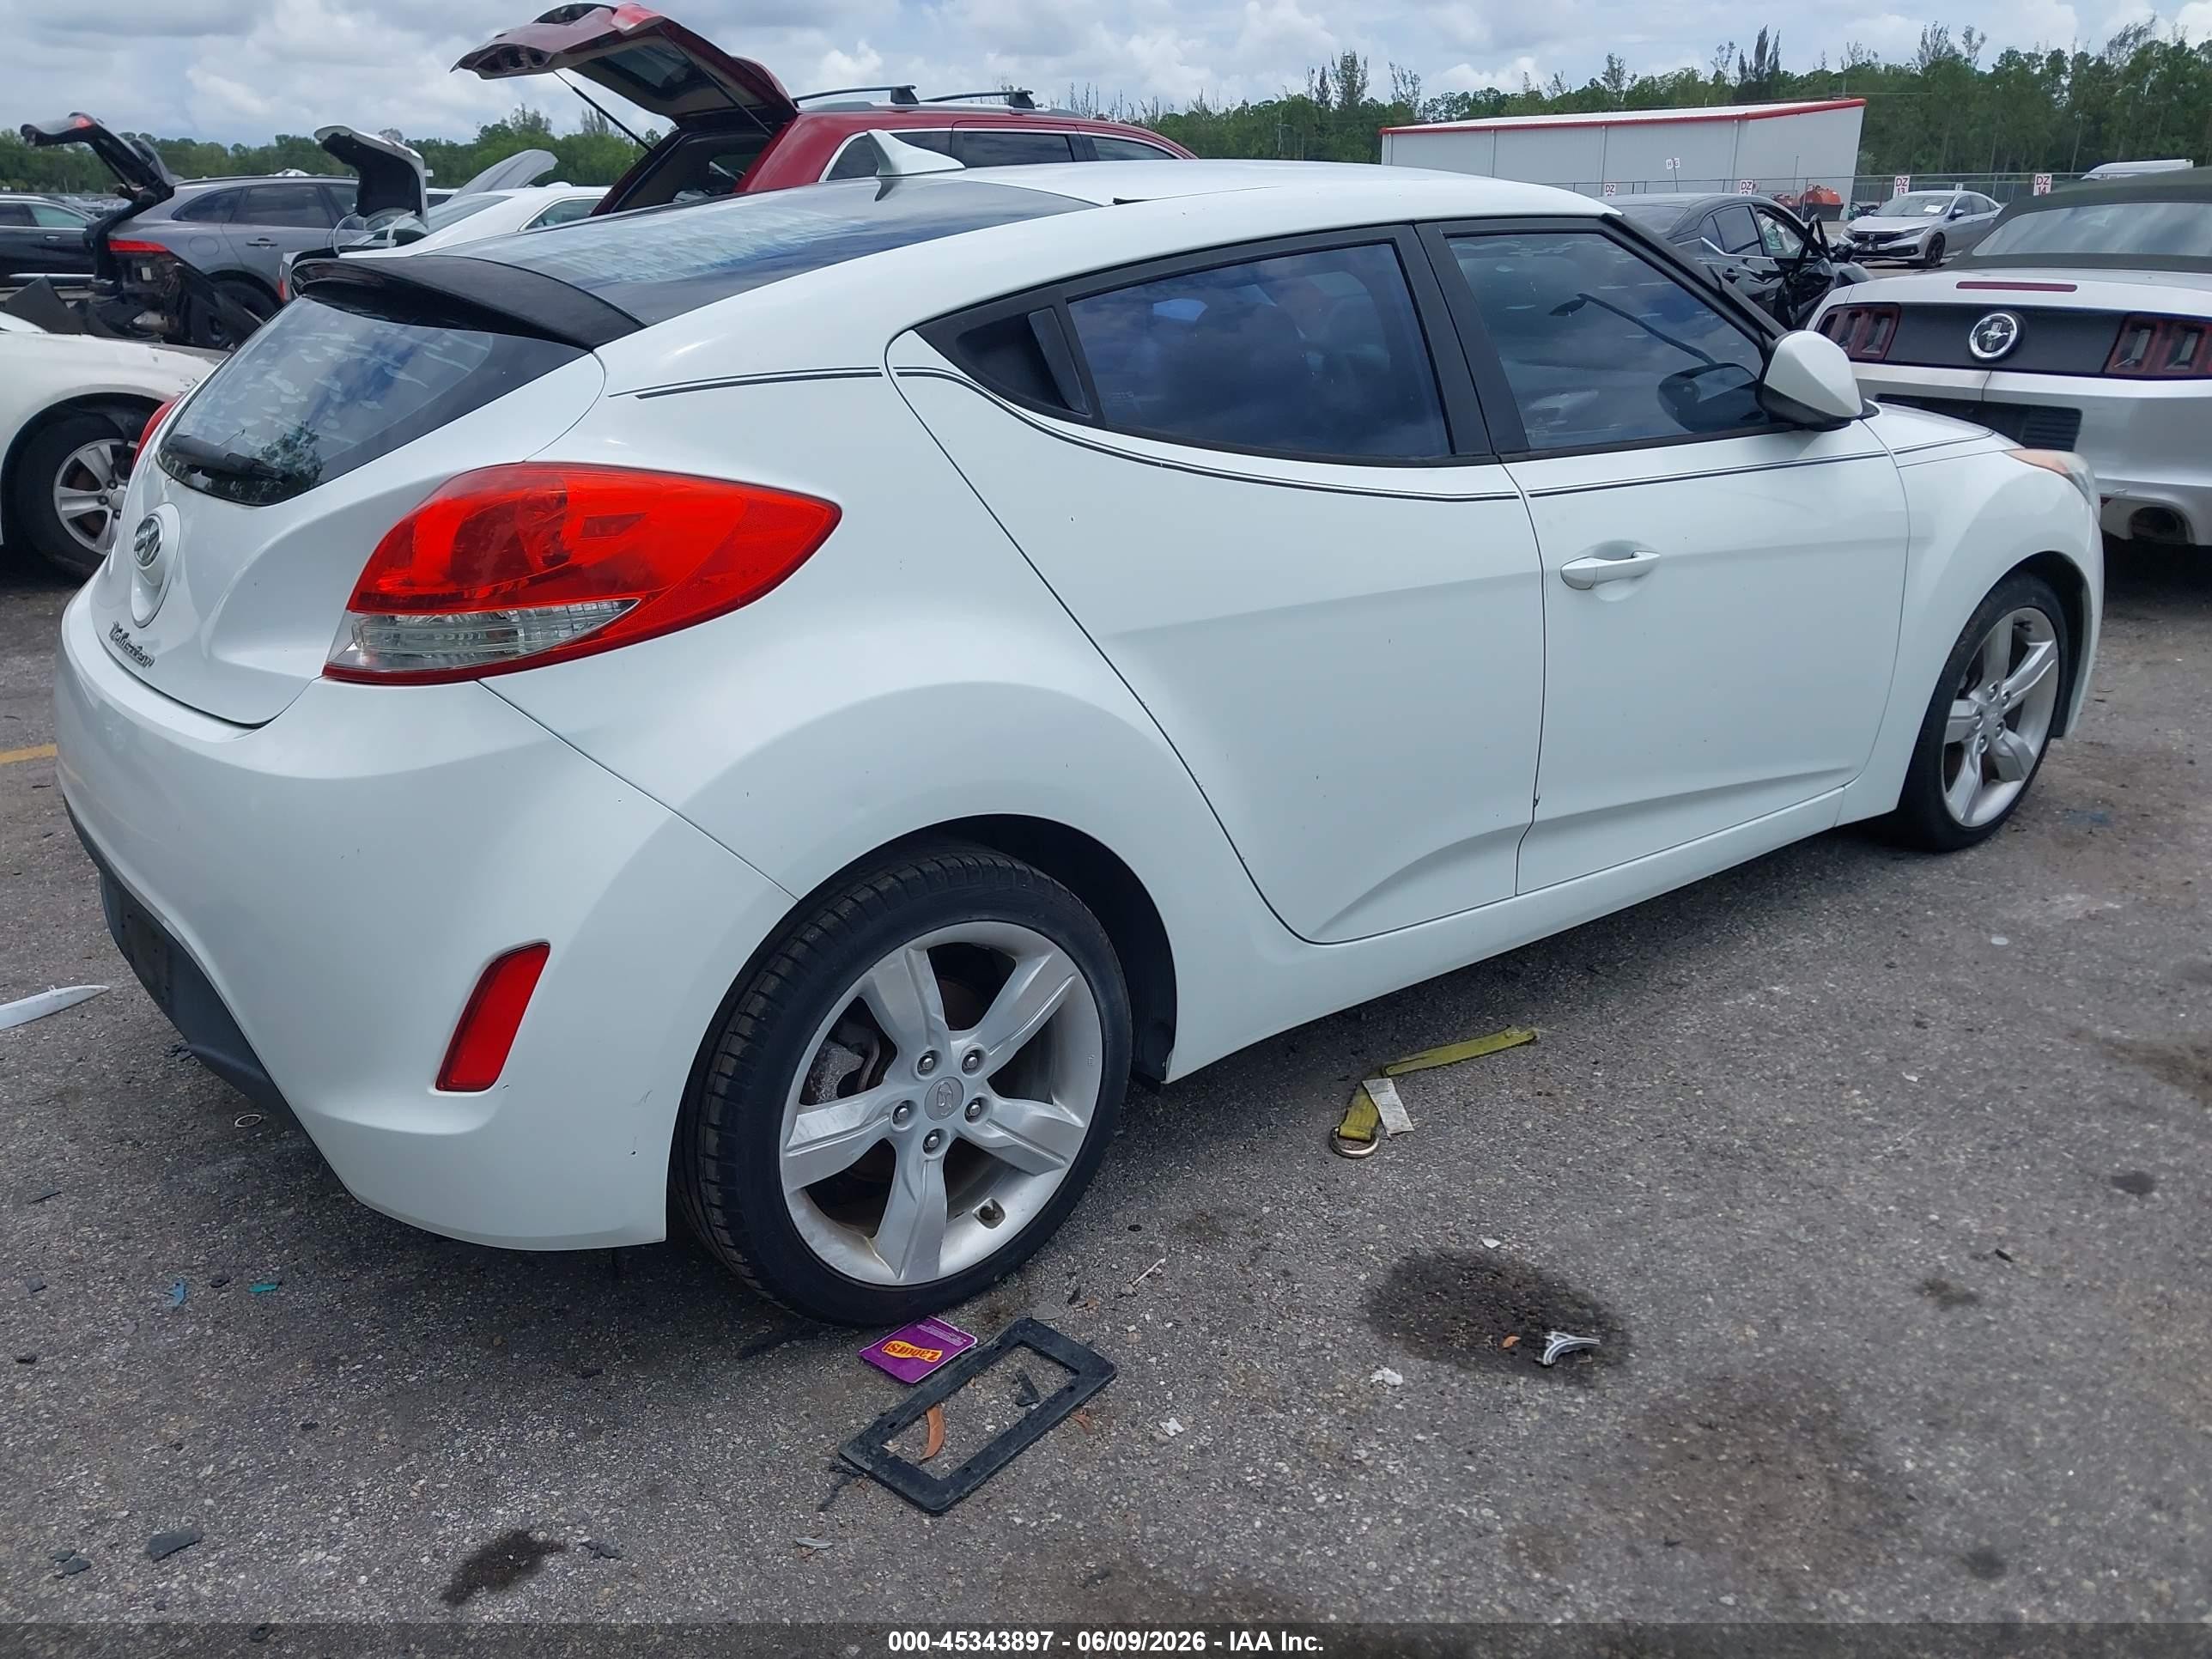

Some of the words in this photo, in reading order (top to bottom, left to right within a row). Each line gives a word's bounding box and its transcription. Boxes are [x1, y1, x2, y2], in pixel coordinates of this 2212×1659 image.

[1896, 177, 1908, 186] DZ
[2037, 175, 2050, 185] DZ
[1606, 184, 1615, 193] DZ
[1741, 181, 1753, 190] DZ
